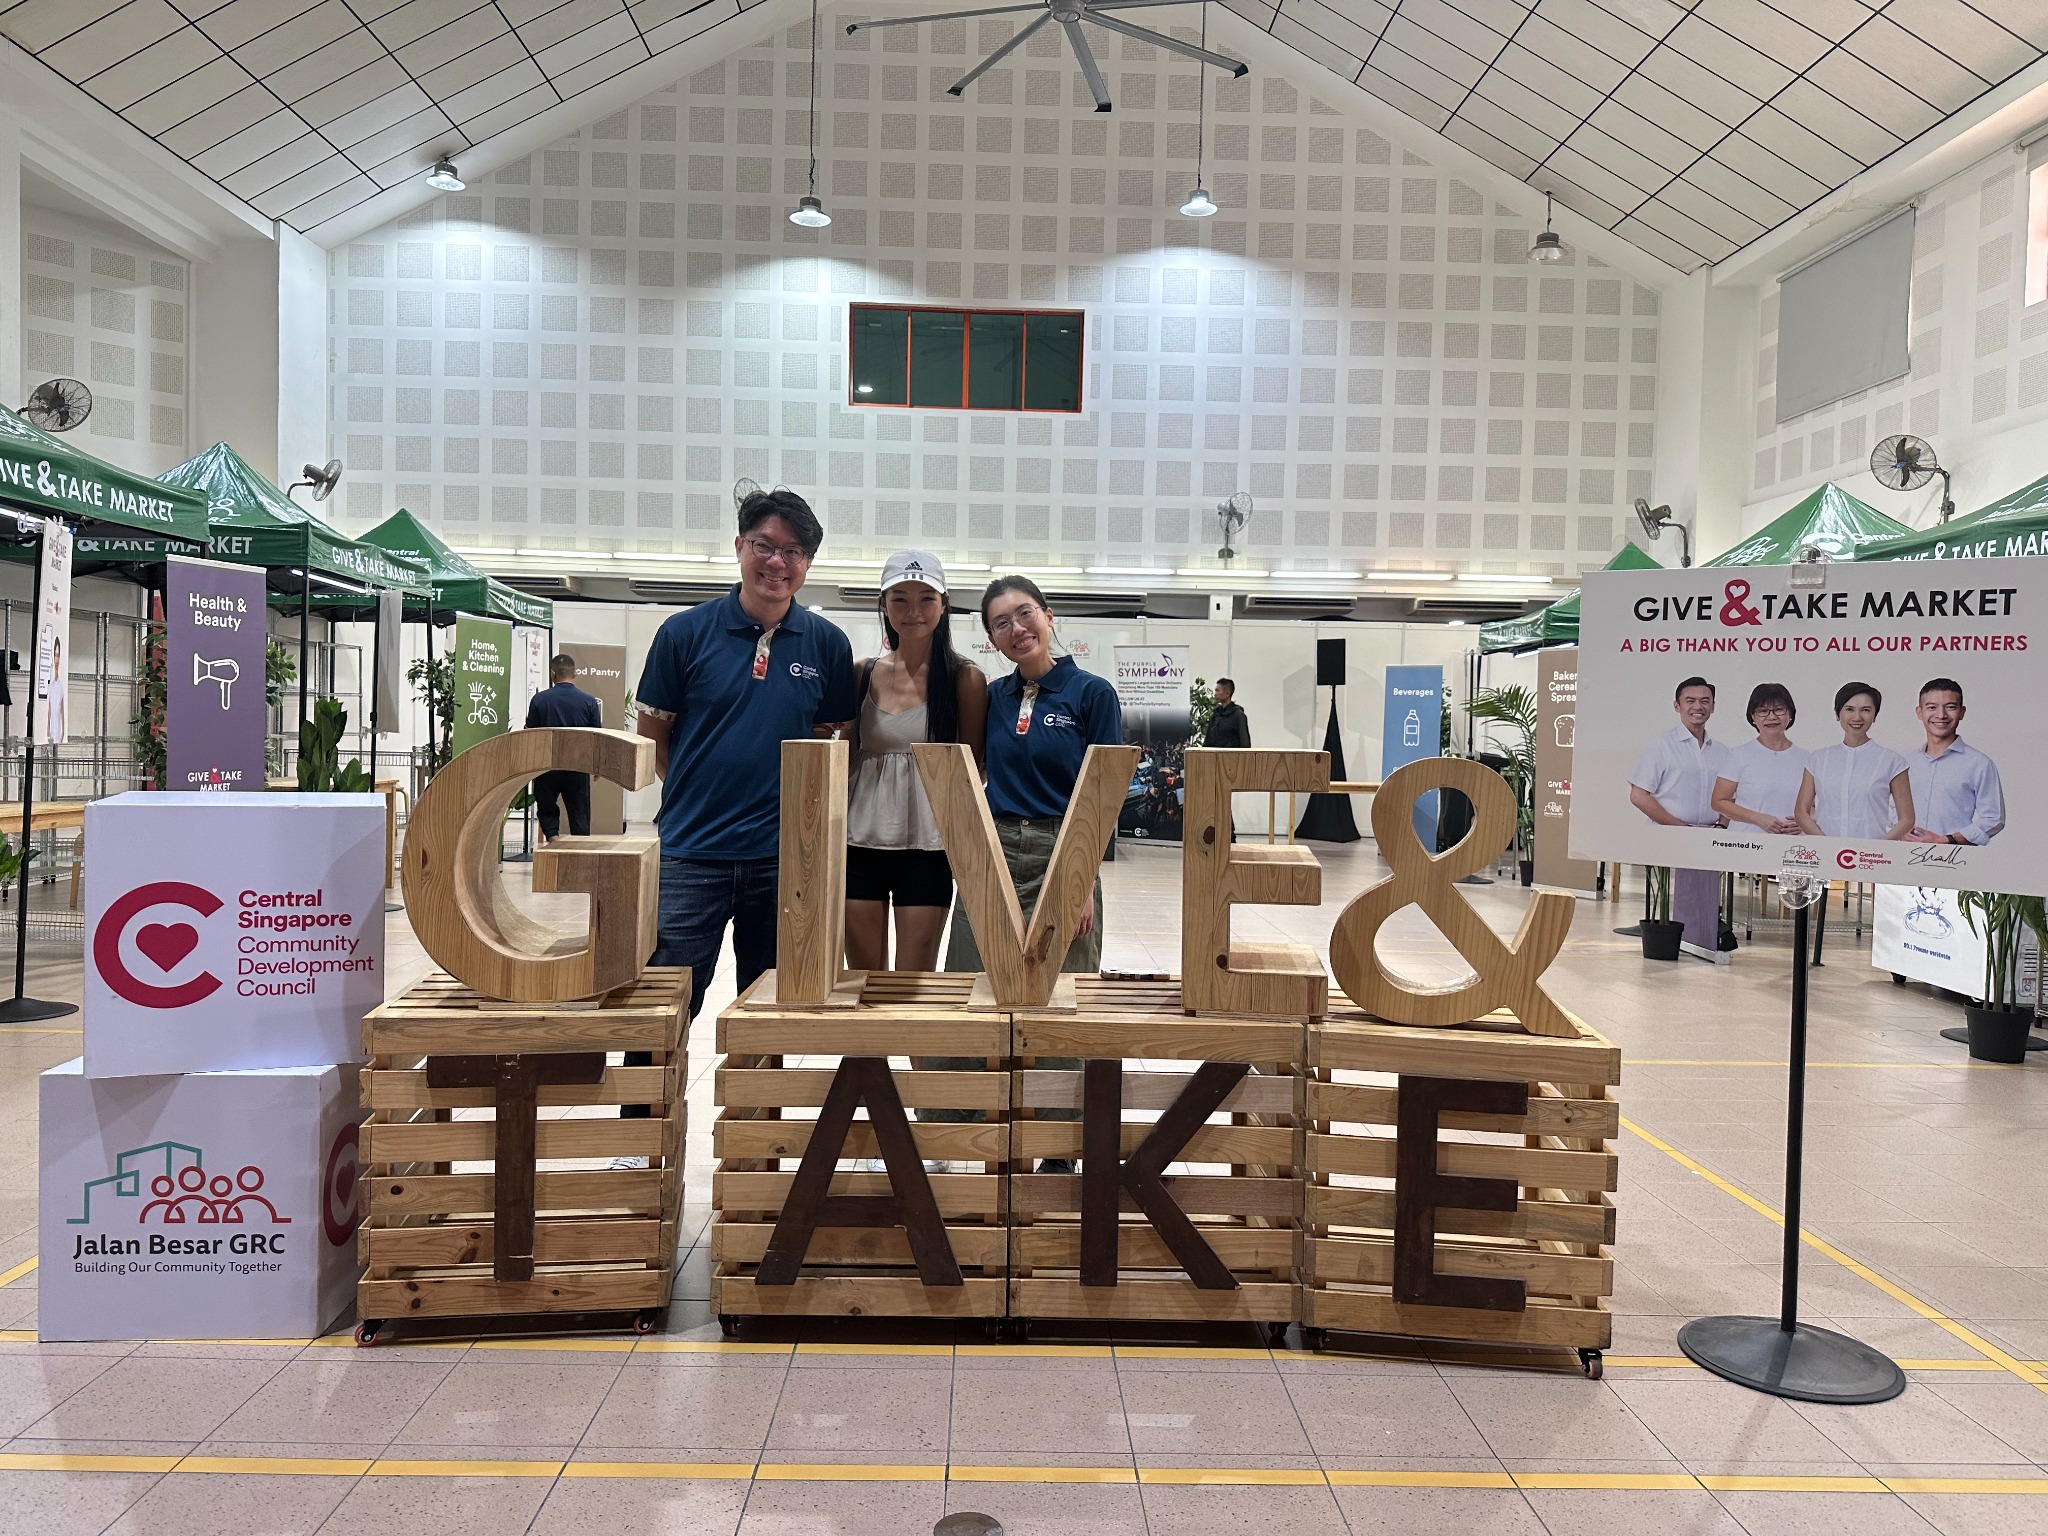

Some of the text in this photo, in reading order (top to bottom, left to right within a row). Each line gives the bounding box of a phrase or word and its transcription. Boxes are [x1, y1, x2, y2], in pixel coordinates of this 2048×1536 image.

[0, 457, 174, 523] IVE & TAKE MARKET
[2004, 530, 2048, 557] MAR
[332, 547, 416, 585] GIVE & TAKE MARKET
[189, 593, 247, 613] Health &
[1633, 578, 2017, 626] GIVE & TAKE MARKET
[194, 610, 242, 631] Beauty
[471, 638, 498, 653] Home,
[985, 642, 991, 650] &
[1620, 634, 2028, 652] A BIG THANK YOU TO ALL OUR PARTNERS
[468, 652, 499, 663] Kitchen
[462, 661, 505, 676] & Cleaning
[590, 668, 621, 678] Pantry
[1118, 667, 1185, 677] SYMPHONY
[1553, 671, 1577, 681] Baker
[1393, 687, 1434, 697] Beverages
[1548, 682, 1577, 691] Cereal
[1551, 692, 1576, 703] Sprea
[187, 765, 242, 783] GIVE & TAKE
[200, 783, 231, 792] MARKET
[1712, 840, 1749, 849] Presented
[1859, 857, 1892, 865] Singapore
[403, 727, 1581, 1037] GIVE &
[238, 888, 322, 907] Central
[237, 911, 352, 932] Singapore
[237, 935, 360, 956] Community
[238, 956, 374, 977] Development
[237, 978, 315, 996] Council
[426, 1052, 1529, 1311] TAKE
[73, 1233, 285, 1259] Jalan Besar GRC
[75, 1261, 282, 1276] Building Our Community Together
